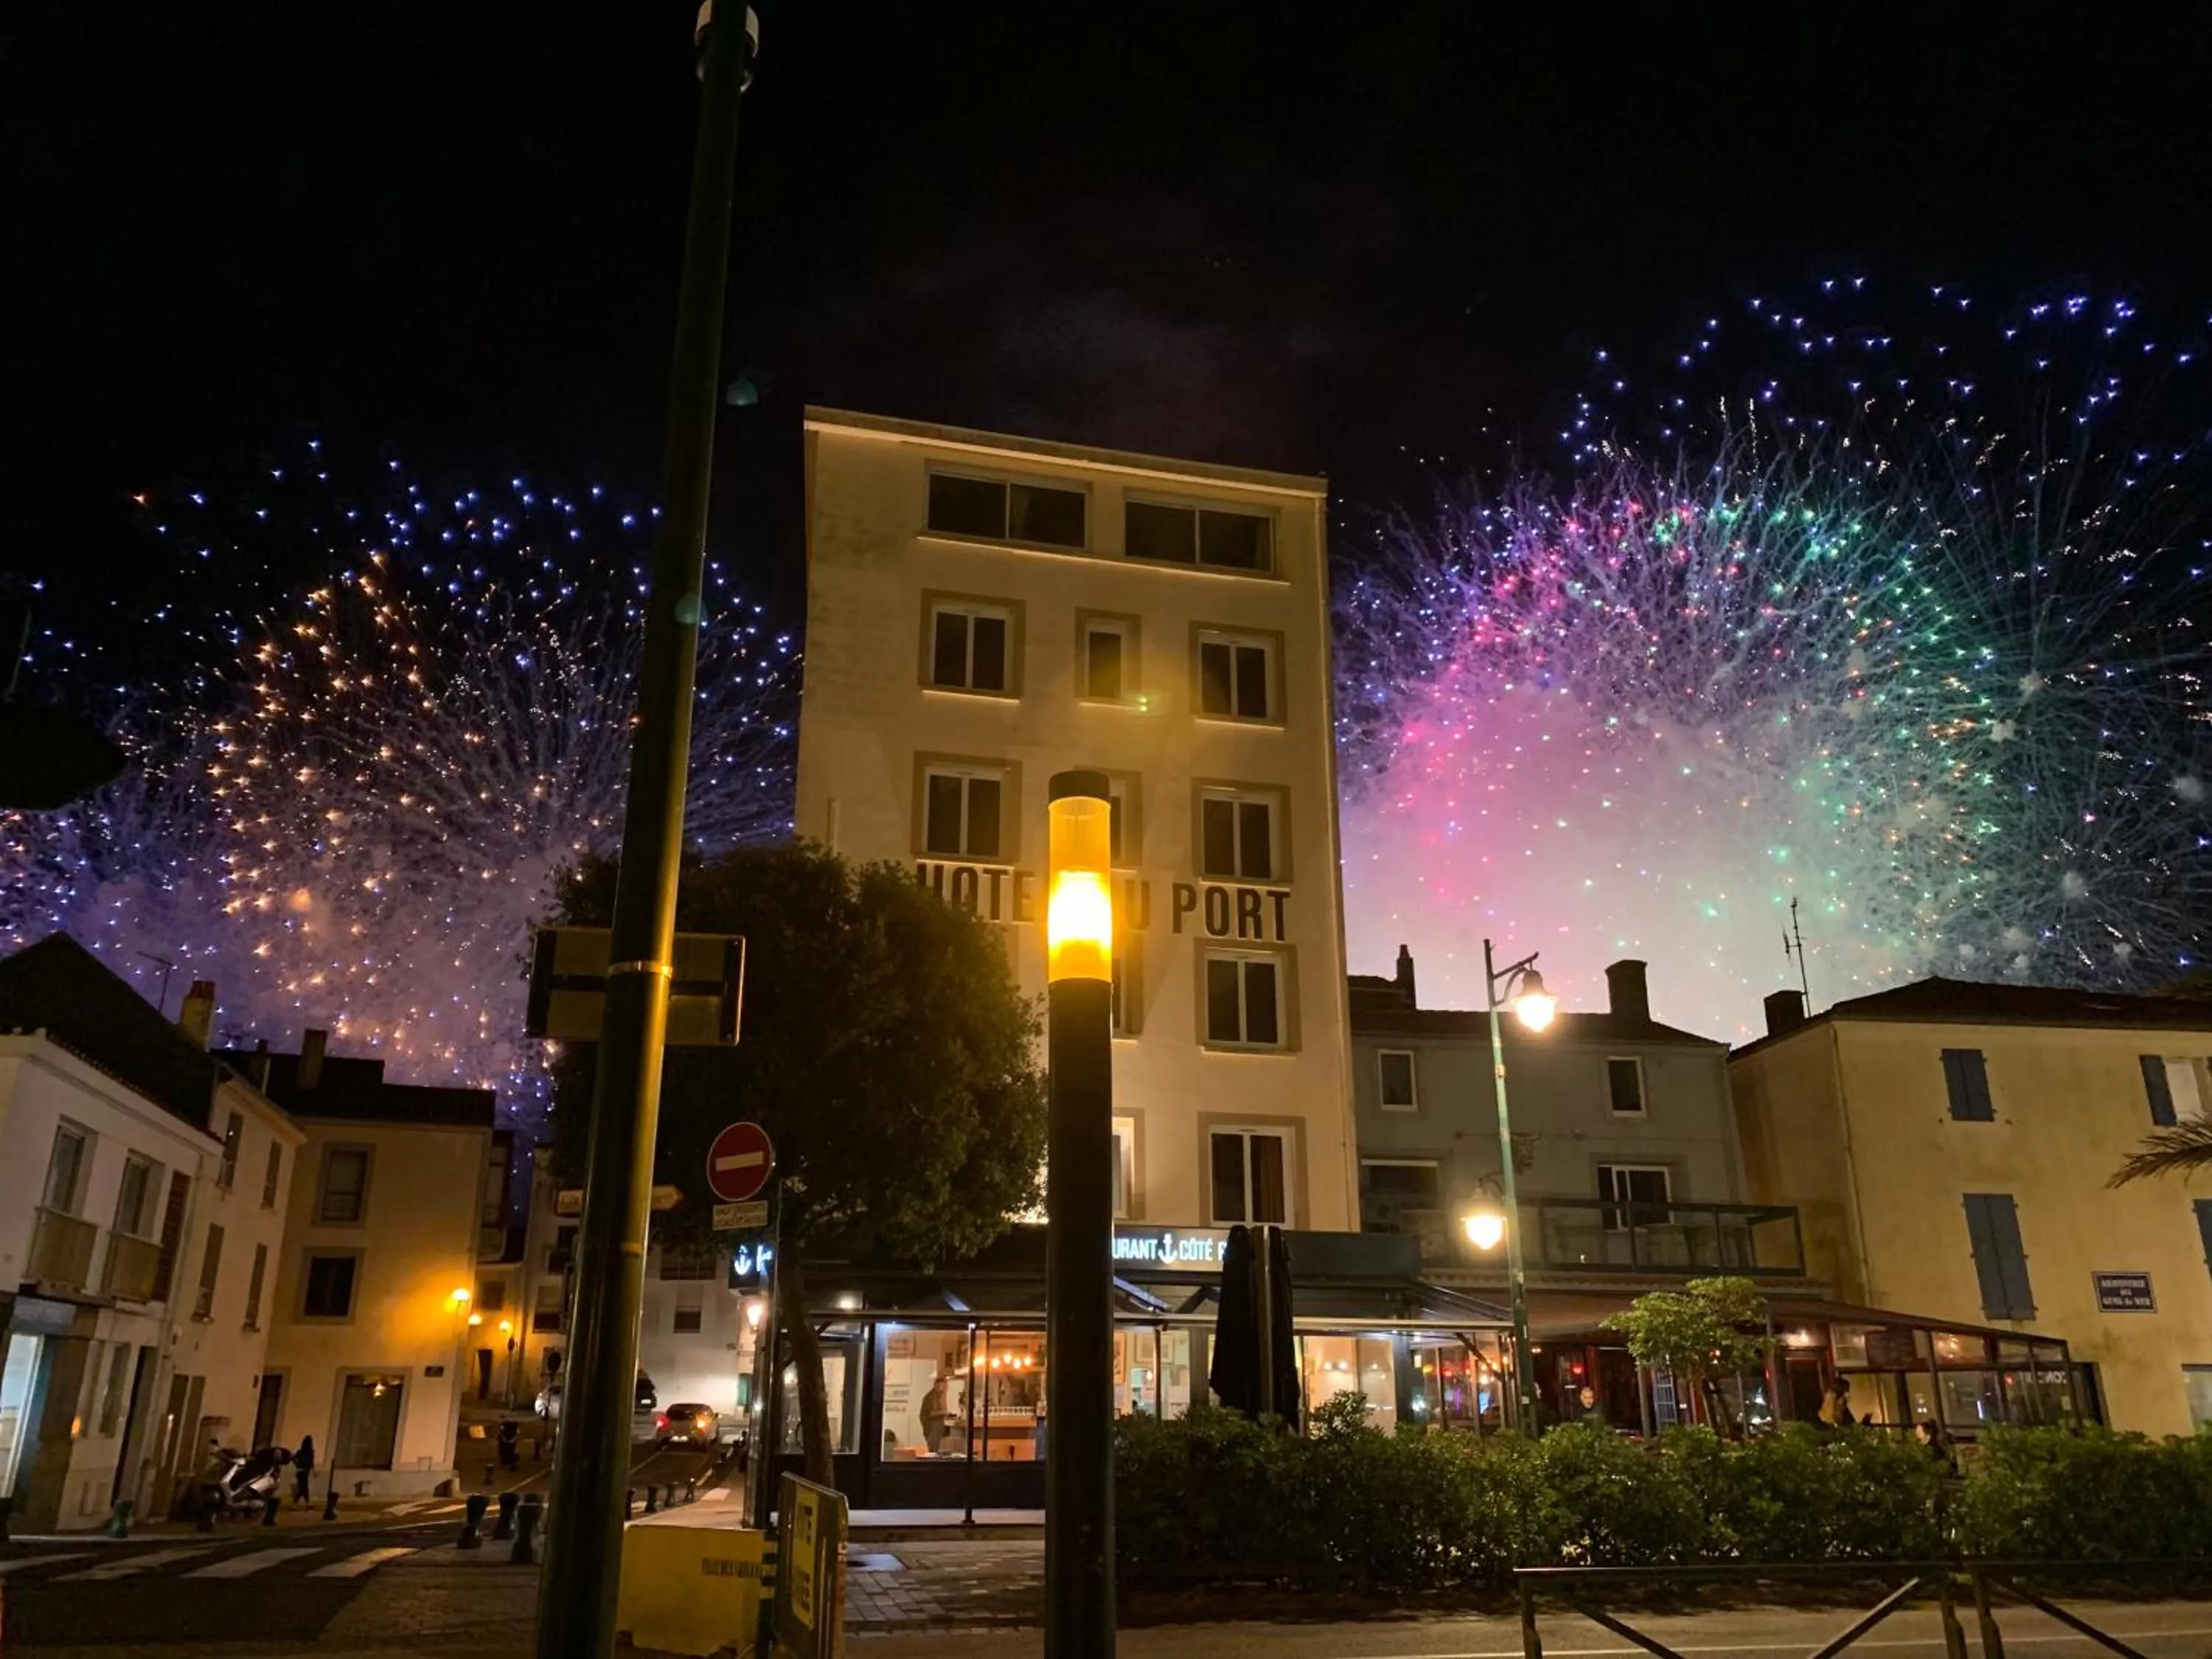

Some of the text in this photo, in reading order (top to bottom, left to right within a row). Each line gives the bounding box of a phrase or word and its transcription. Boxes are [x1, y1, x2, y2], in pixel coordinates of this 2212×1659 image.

[1124, 878, 1150, 931] U
[1172, 882, 1290, 942] PORT
[1112, 1238, 1158, 1260] URANT
[1179, 1237, 1213, 1262] CÔTÉ
